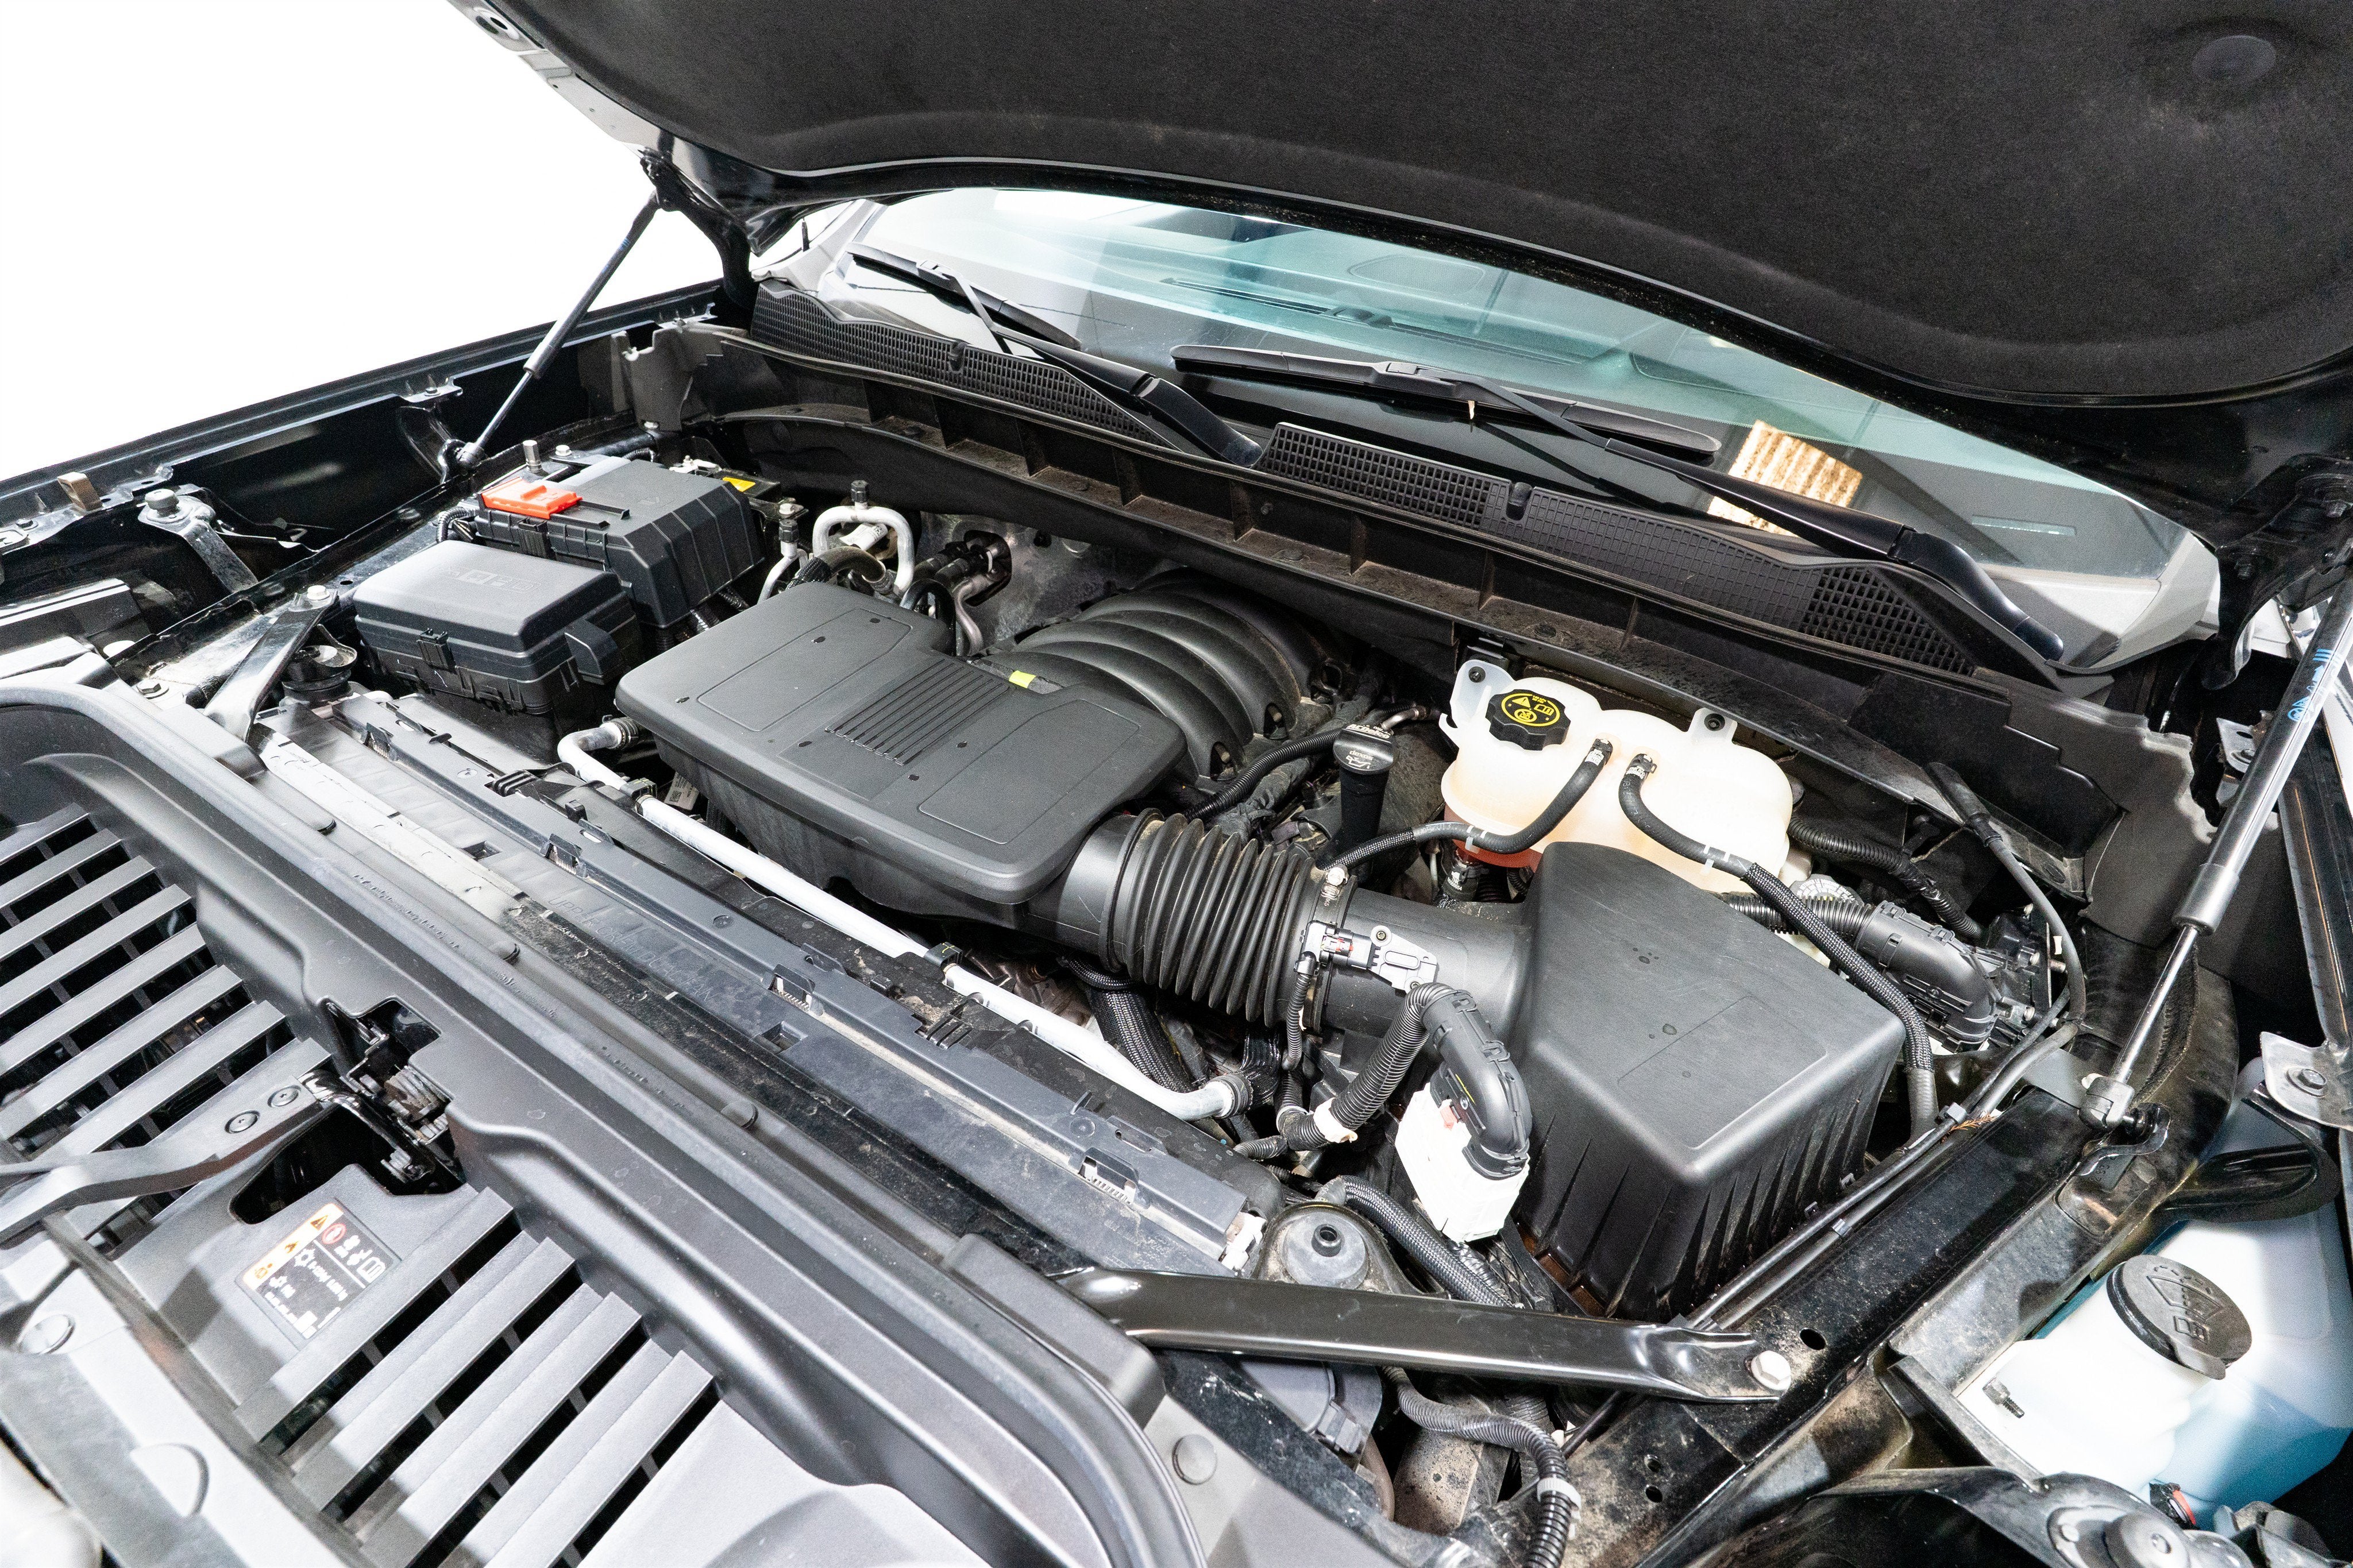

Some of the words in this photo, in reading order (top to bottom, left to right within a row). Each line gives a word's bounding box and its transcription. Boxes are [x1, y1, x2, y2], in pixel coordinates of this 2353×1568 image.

[1347, 723, 1390, 740] ACDelco
[1349, 750, 1374, 761] dexos
[547, 896, 599, 929] UPPER
